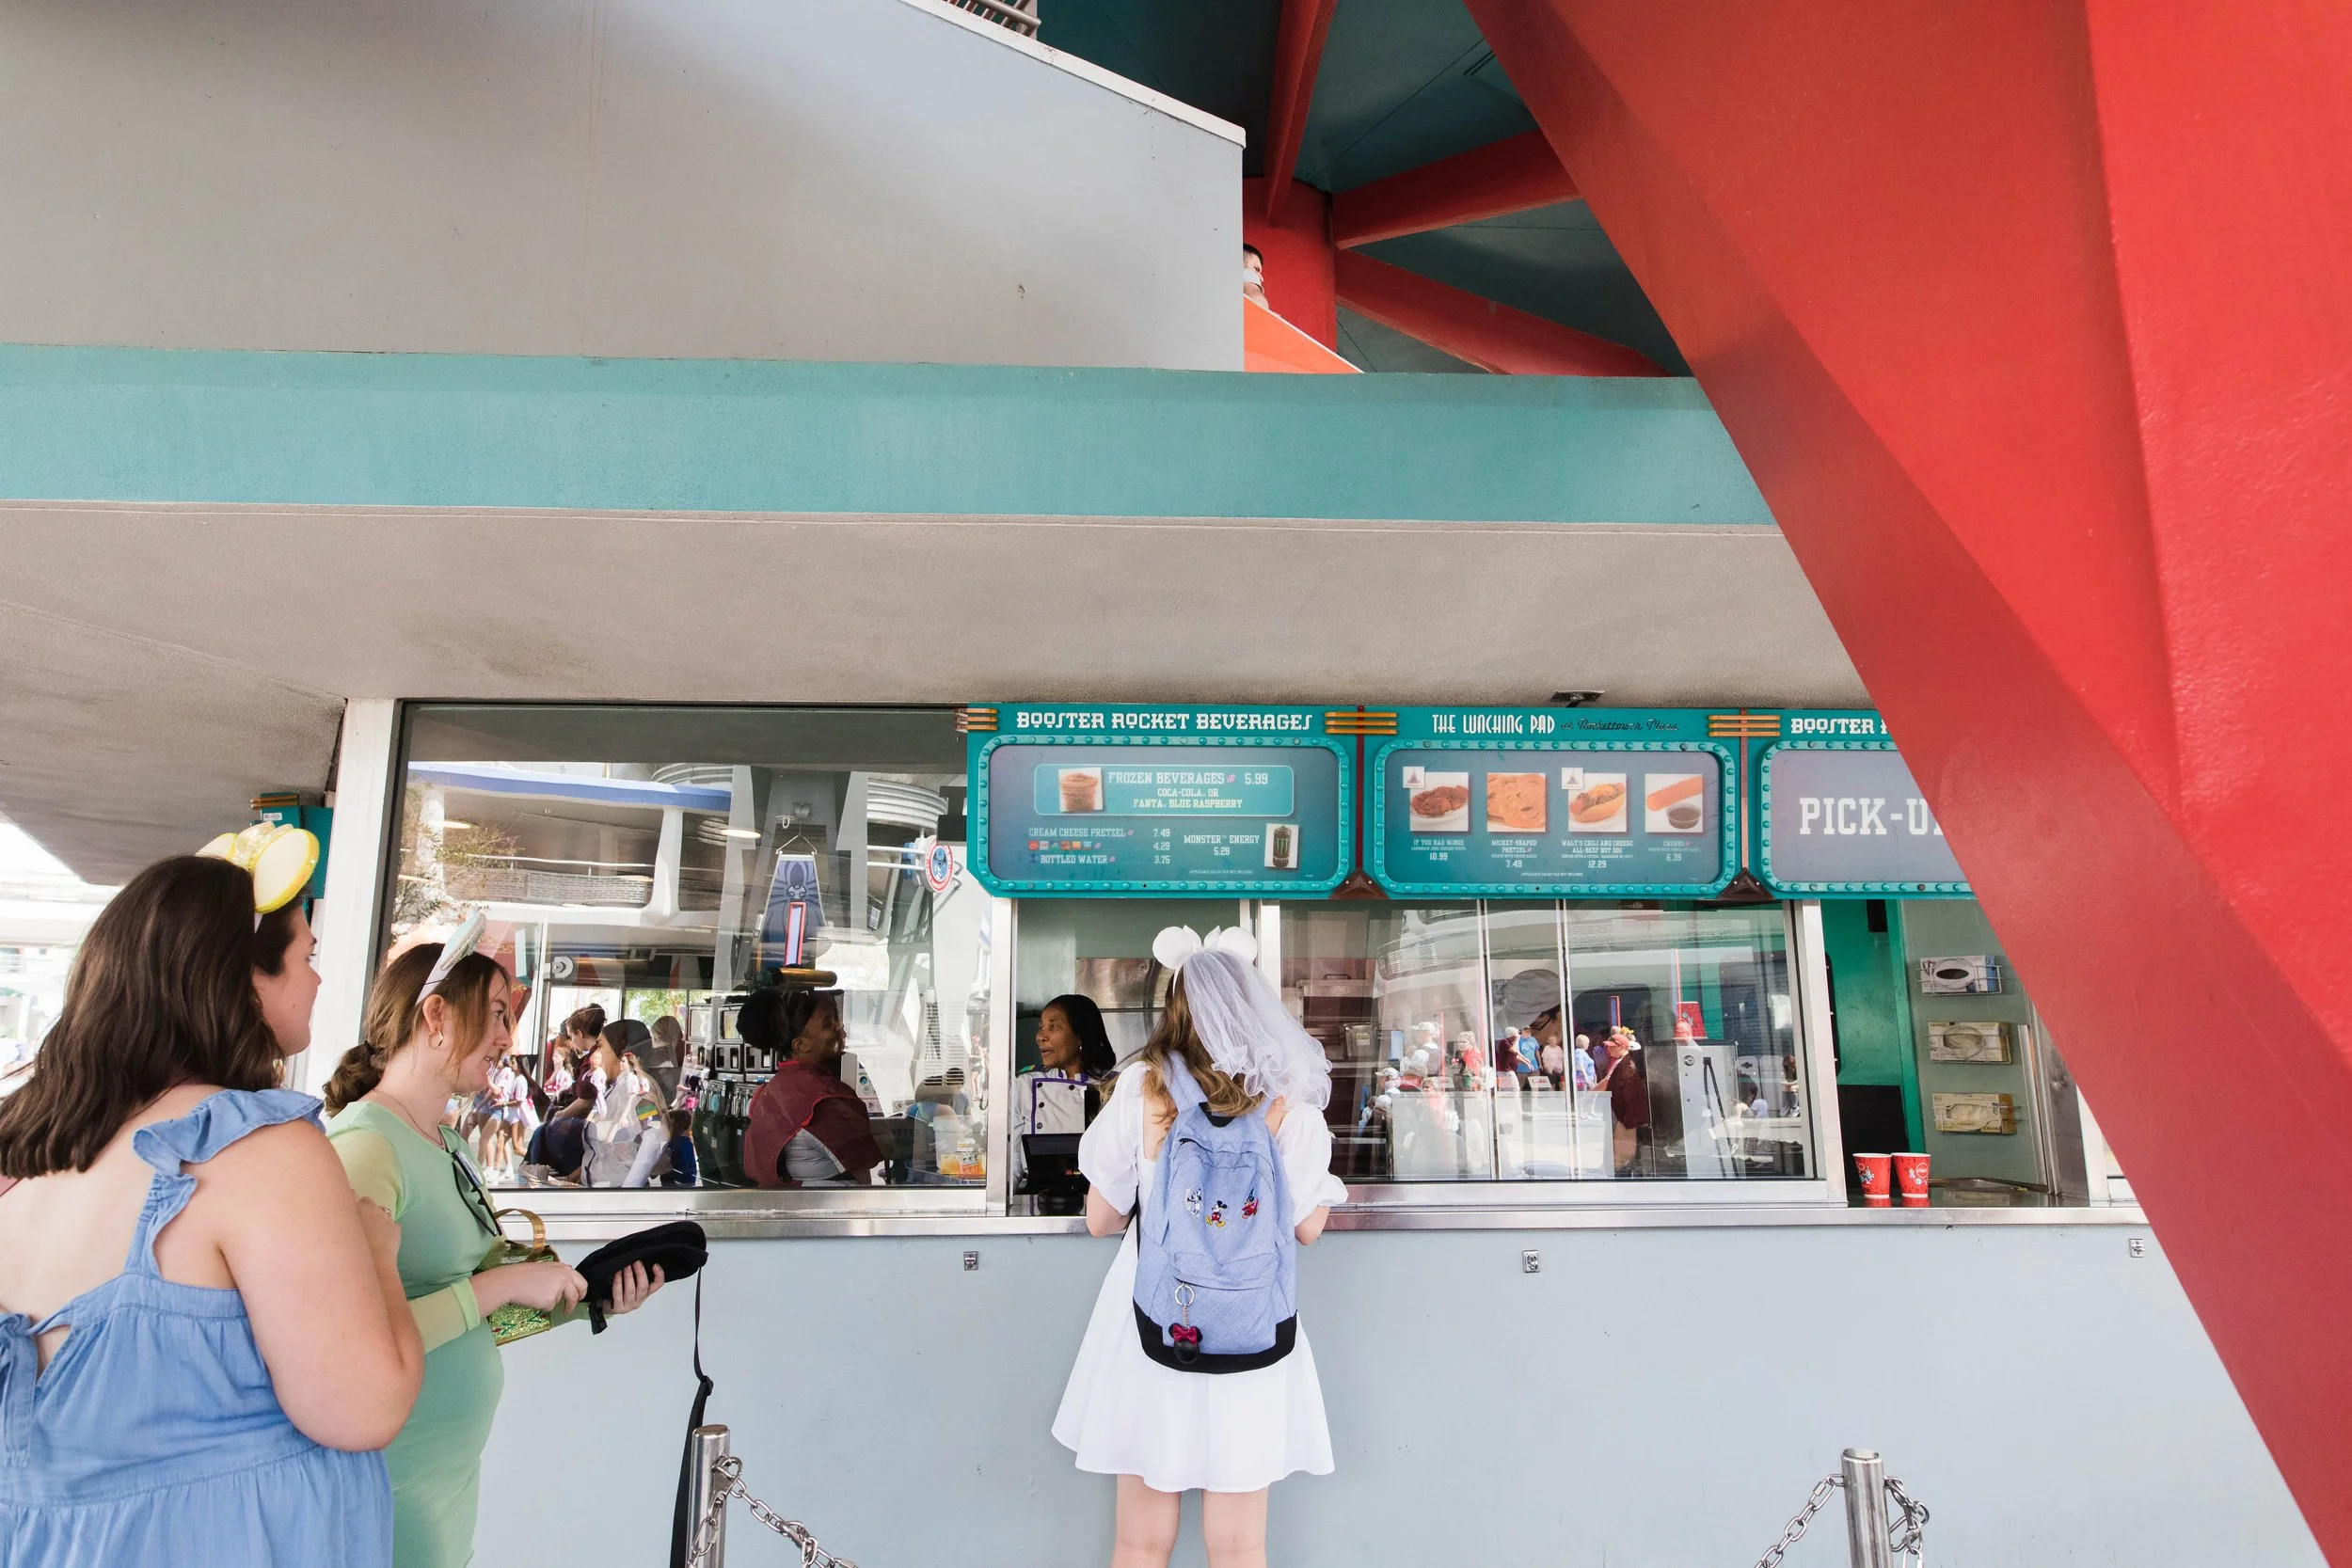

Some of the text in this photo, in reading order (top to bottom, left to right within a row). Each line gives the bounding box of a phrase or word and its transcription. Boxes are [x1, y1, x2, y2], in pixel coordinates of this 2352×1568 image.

[1016, 712, 1313, 731] BOOSTER ROCKET BEVERAGES
[1432, 714, 1456, 734] THE
[1462, 714, 1523, 734] LUNCHING
[1530, 714, 1555, 734] PAD
[1790, 718, 1875, 734] BOOSTER
[1107, 772, 1269, 785] FROZEN BEVERAGES 5.99
[1208, 788, 1219, 798] OR
[1168, 799, 1191, 809] BLUE
[1193, 799, 1243, 809] RASPBERRY
[1799, 797, 1945, 835] PICK-U
[1028, 828, 1171, 837] CREAM CHEESE PRETZEL 7.49
[1229, 834, 1261, 844] ENERGY
[1152, 842, 1170, 851] 4.29
[1214, 847, 1231, 856] 5.29
[1041, 854, 1171, 864] BOTTLED WATER 3.75
[1429, 852, 1448, 861] 10.99
[1666, 853, 1682, 862] 6.39
[1505, 860, 1523, 868] 7.49
[1588, 860, 1607, 869] 12.29
